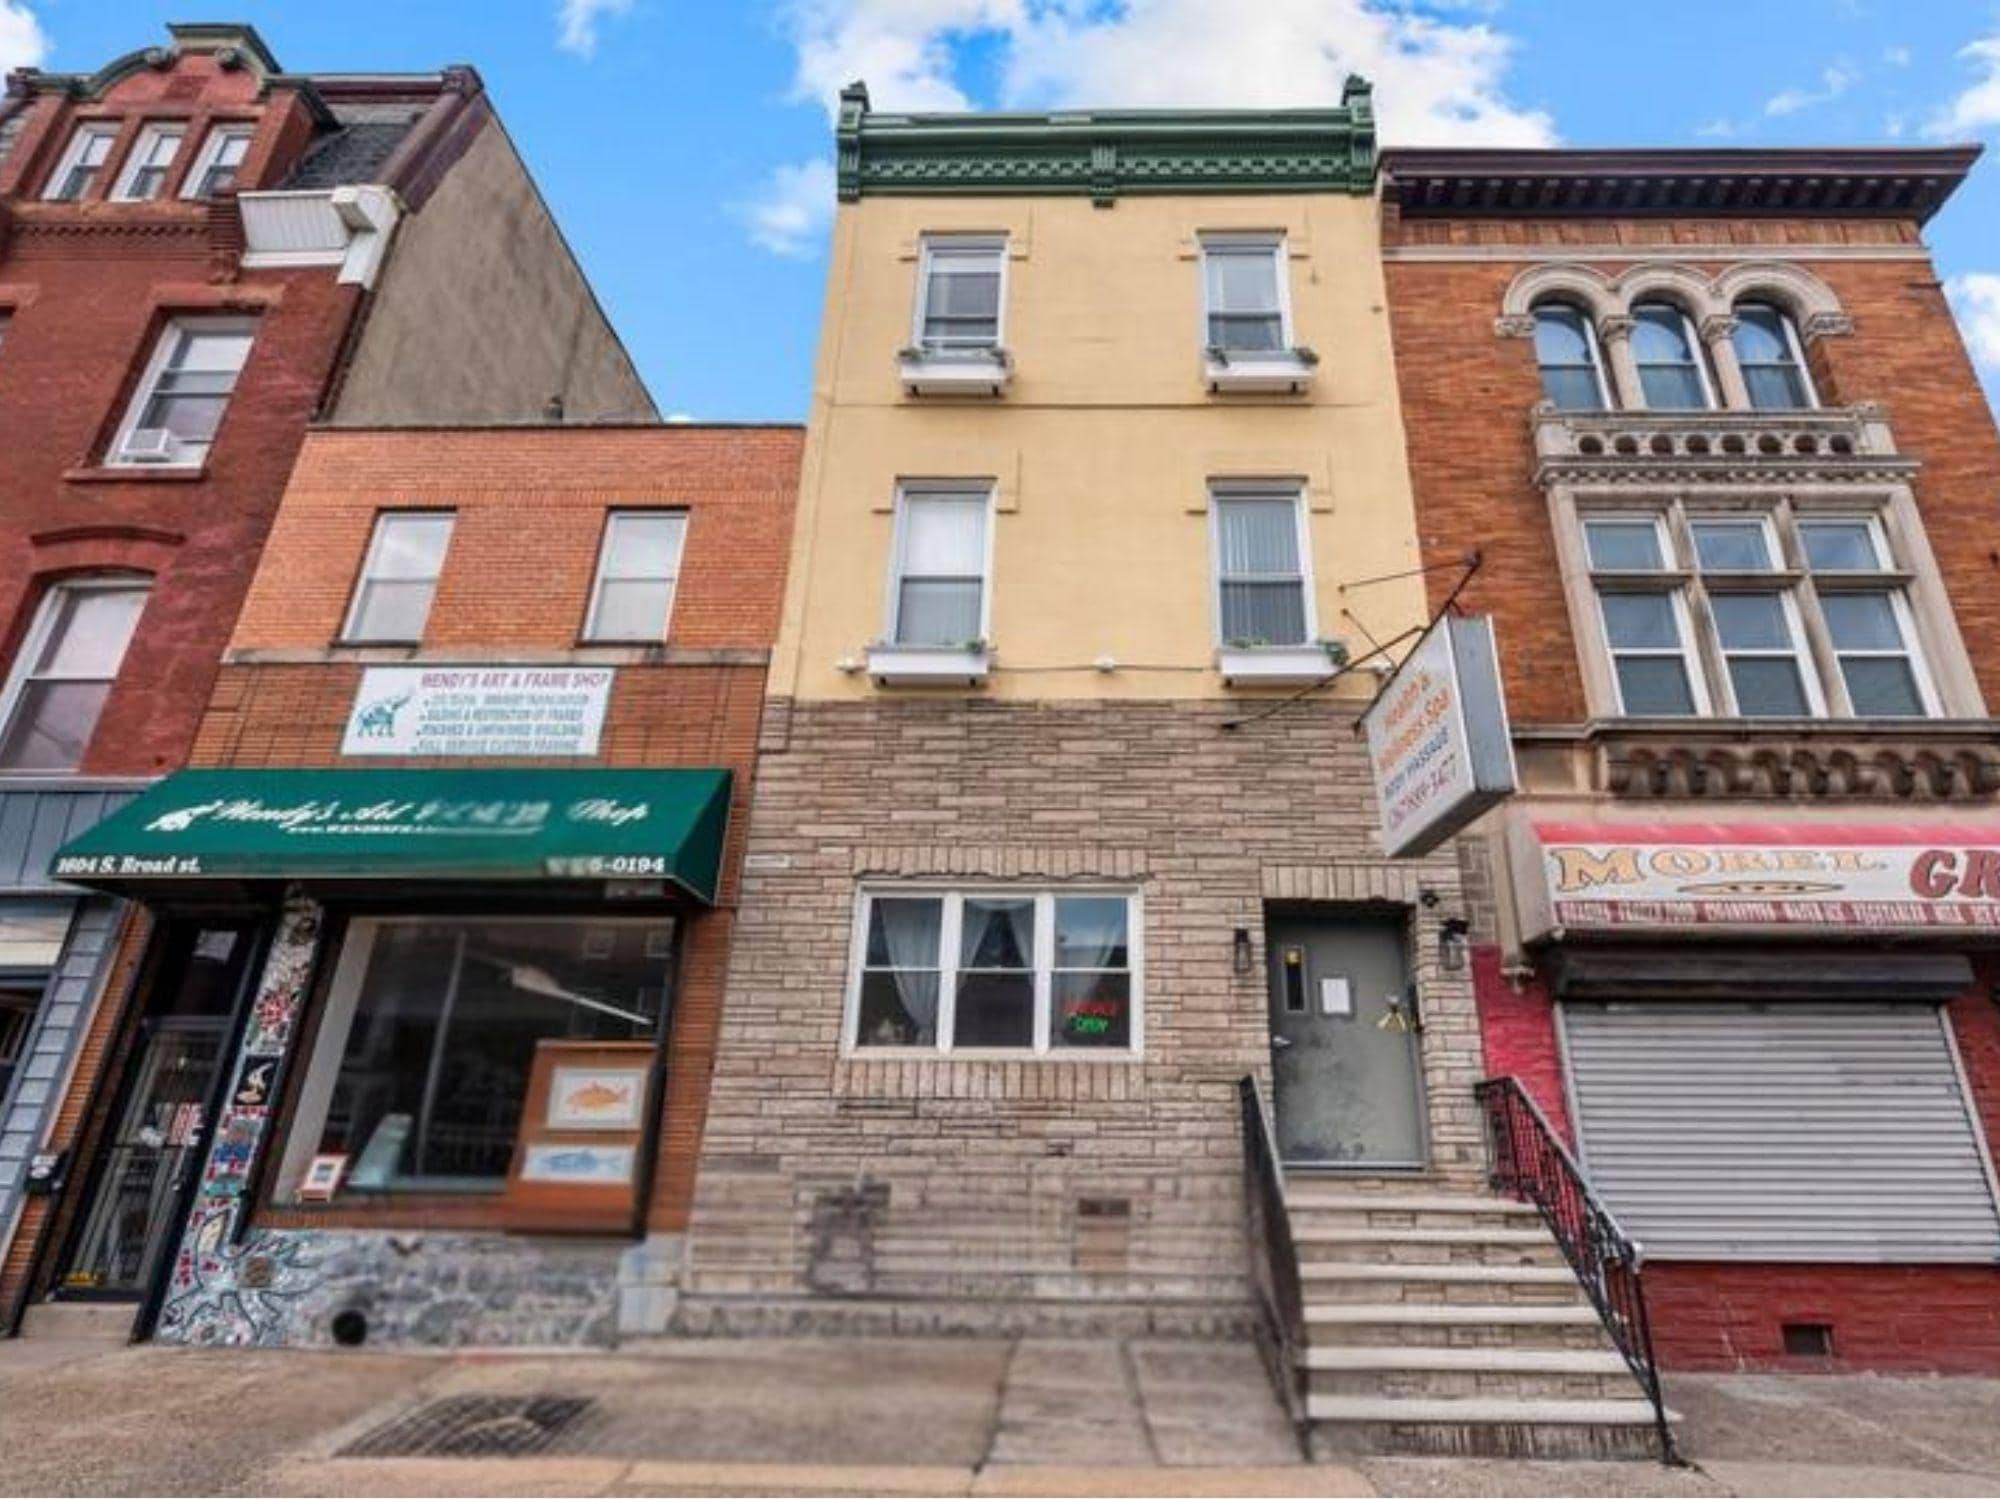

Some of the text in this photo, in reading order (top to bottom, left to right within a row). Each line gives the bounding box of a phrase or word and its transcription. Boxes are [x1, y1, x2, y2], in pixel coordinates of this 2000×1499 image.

[422, 673, 479, 688] WENDY'S
[481, 673, 507, 687] ART
[525, 673, 571, 688] FRAME
[573, 673, 608, 688] SHOP
[119, 855, 177, 873] Broad
